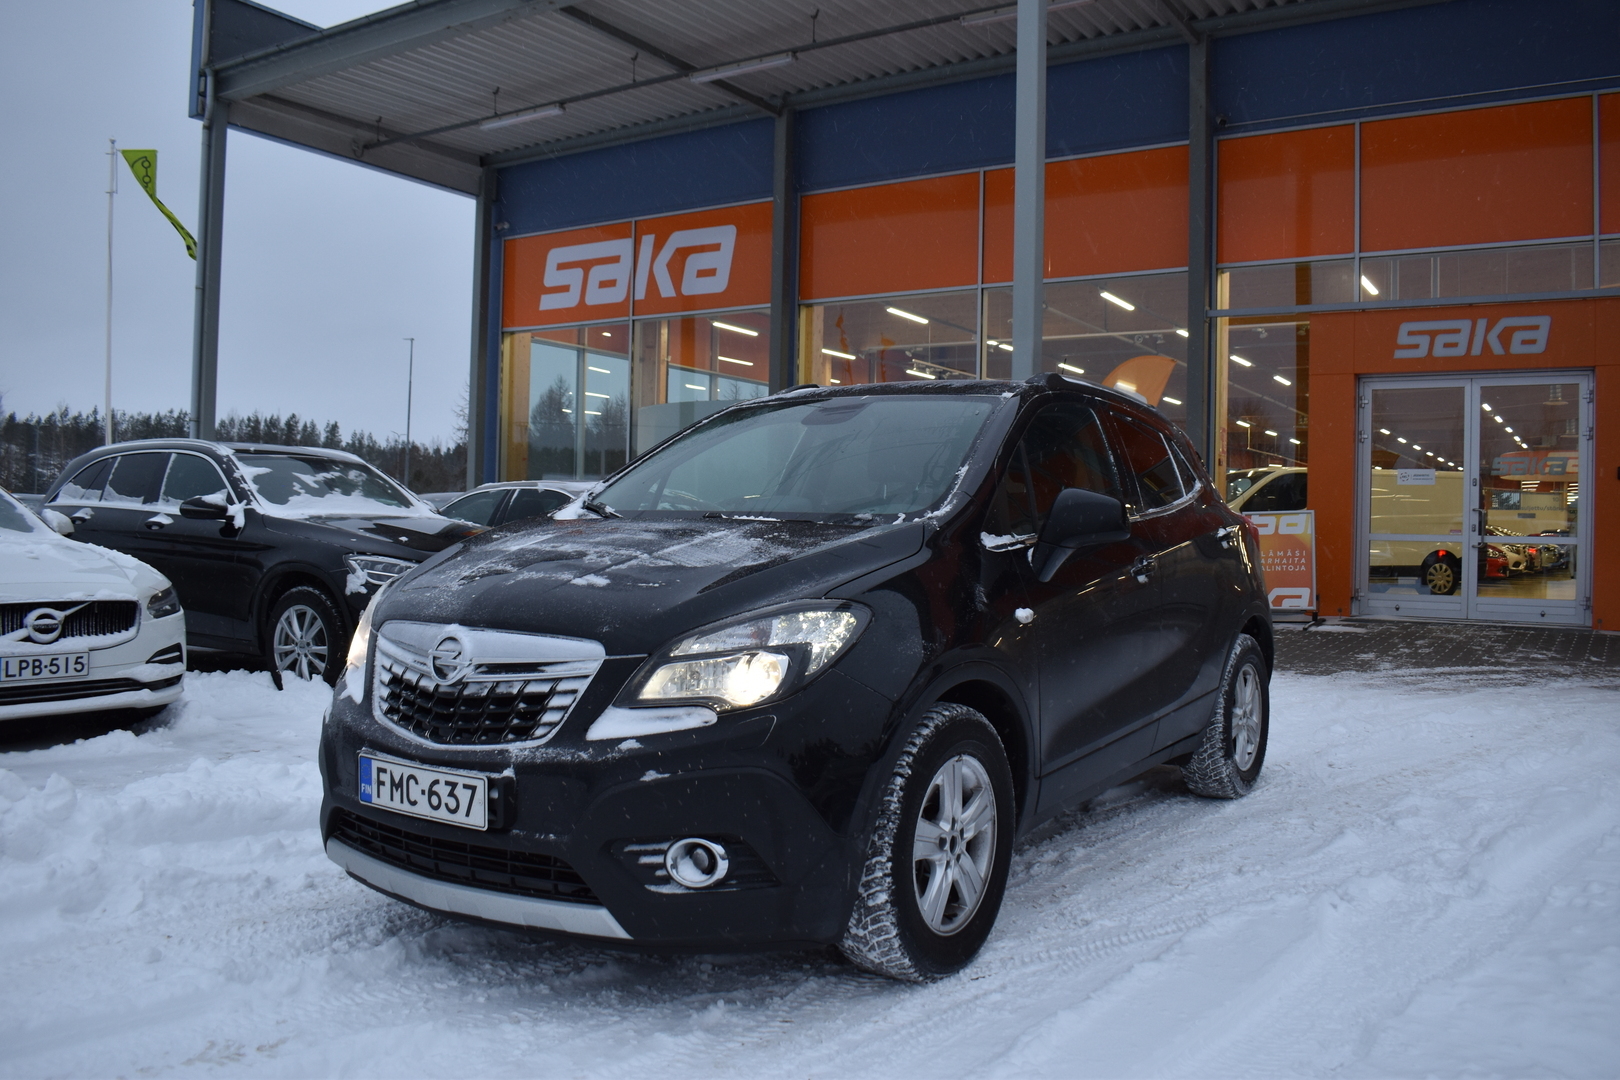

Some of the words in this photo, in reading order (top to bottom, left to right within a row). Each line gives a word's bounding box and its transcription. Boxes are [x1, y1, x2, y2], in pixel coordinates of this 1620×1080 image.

[1260, 548, 1306, 557] LÄMÄSI
[5, 656, 85, 678] LPB-515
[361, 783, 372, 795] FIN
[376, 766, 478, 818] FMC-637
